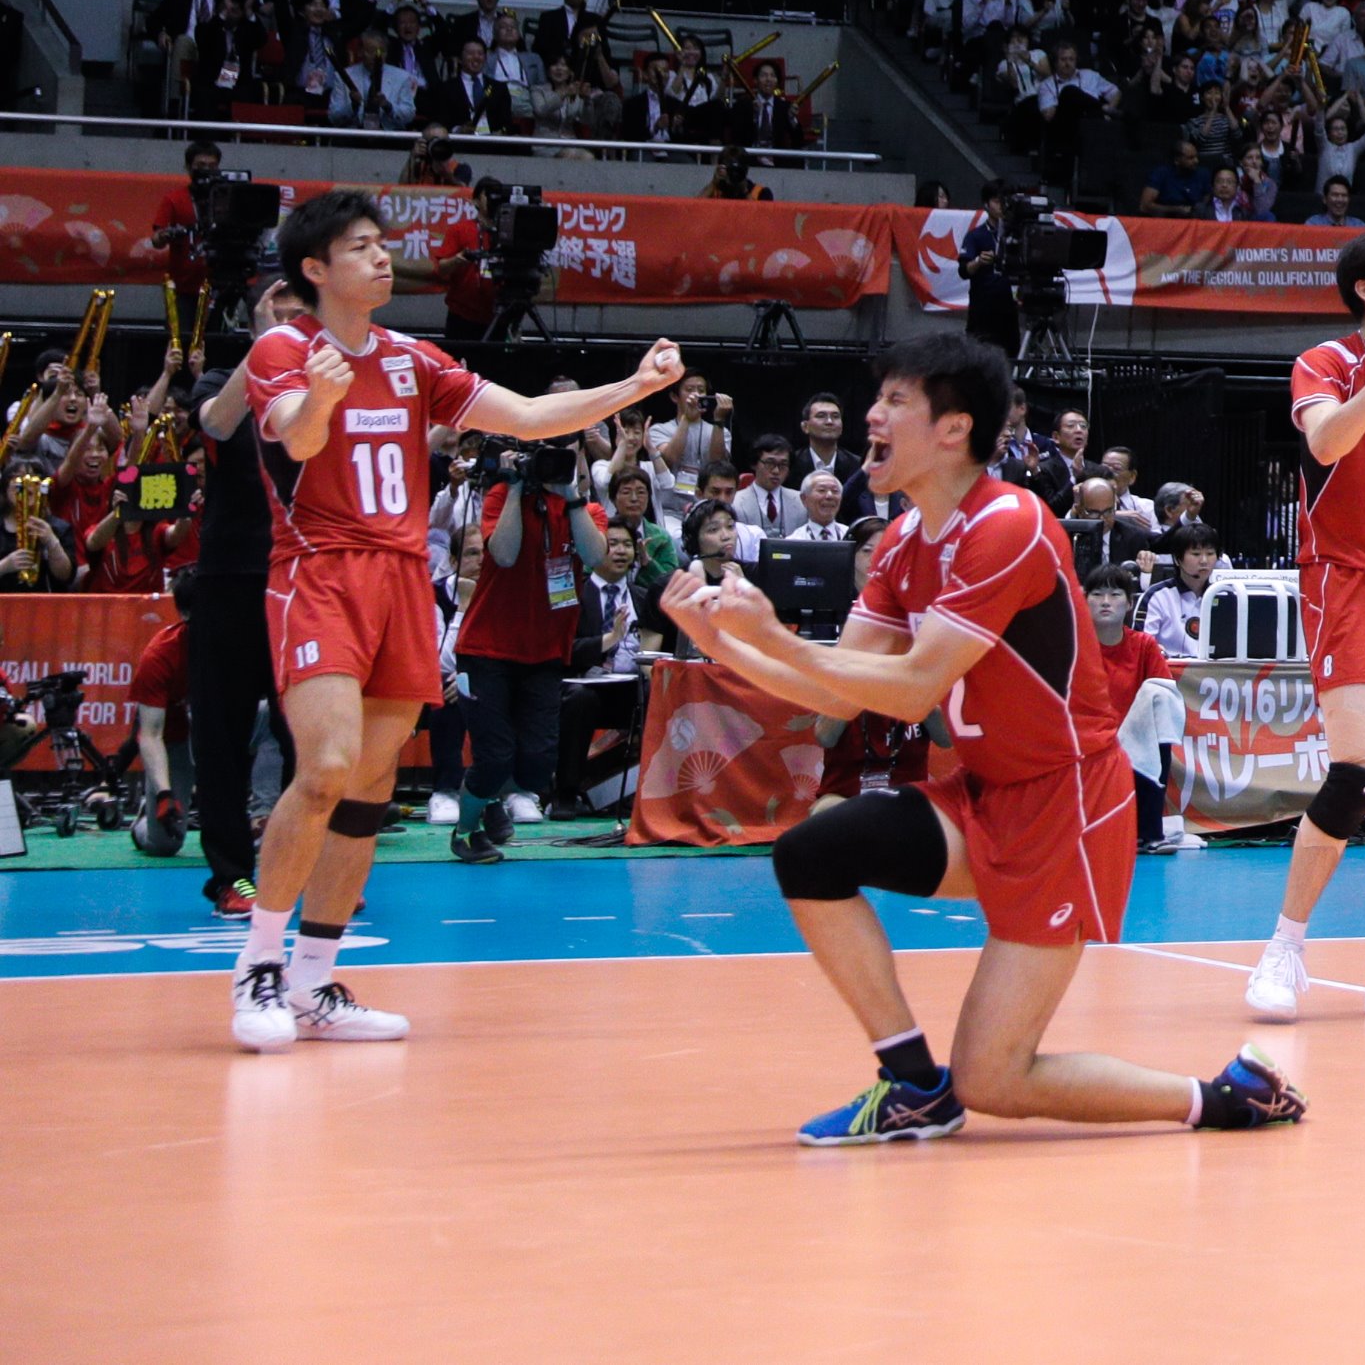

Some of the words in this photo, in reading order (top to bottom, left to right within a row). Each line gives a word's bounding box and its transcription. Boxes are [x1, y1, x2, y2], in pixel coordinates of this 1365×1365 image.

[1235, 247, 1288, 263] WOMEN'S
[1292, 248, 1313, 263] AND
[1183, 269, 1201, 284] THE
[1204, 270, 1255, 285] REGIONAL
[356, 412, 403, 429] Japanet
[351, 442, 408, 515] 18
[295, 640, 320, 668] 18
[1323, 653, 1333, 677] 8
[78, 701, 116, 725] FOR
